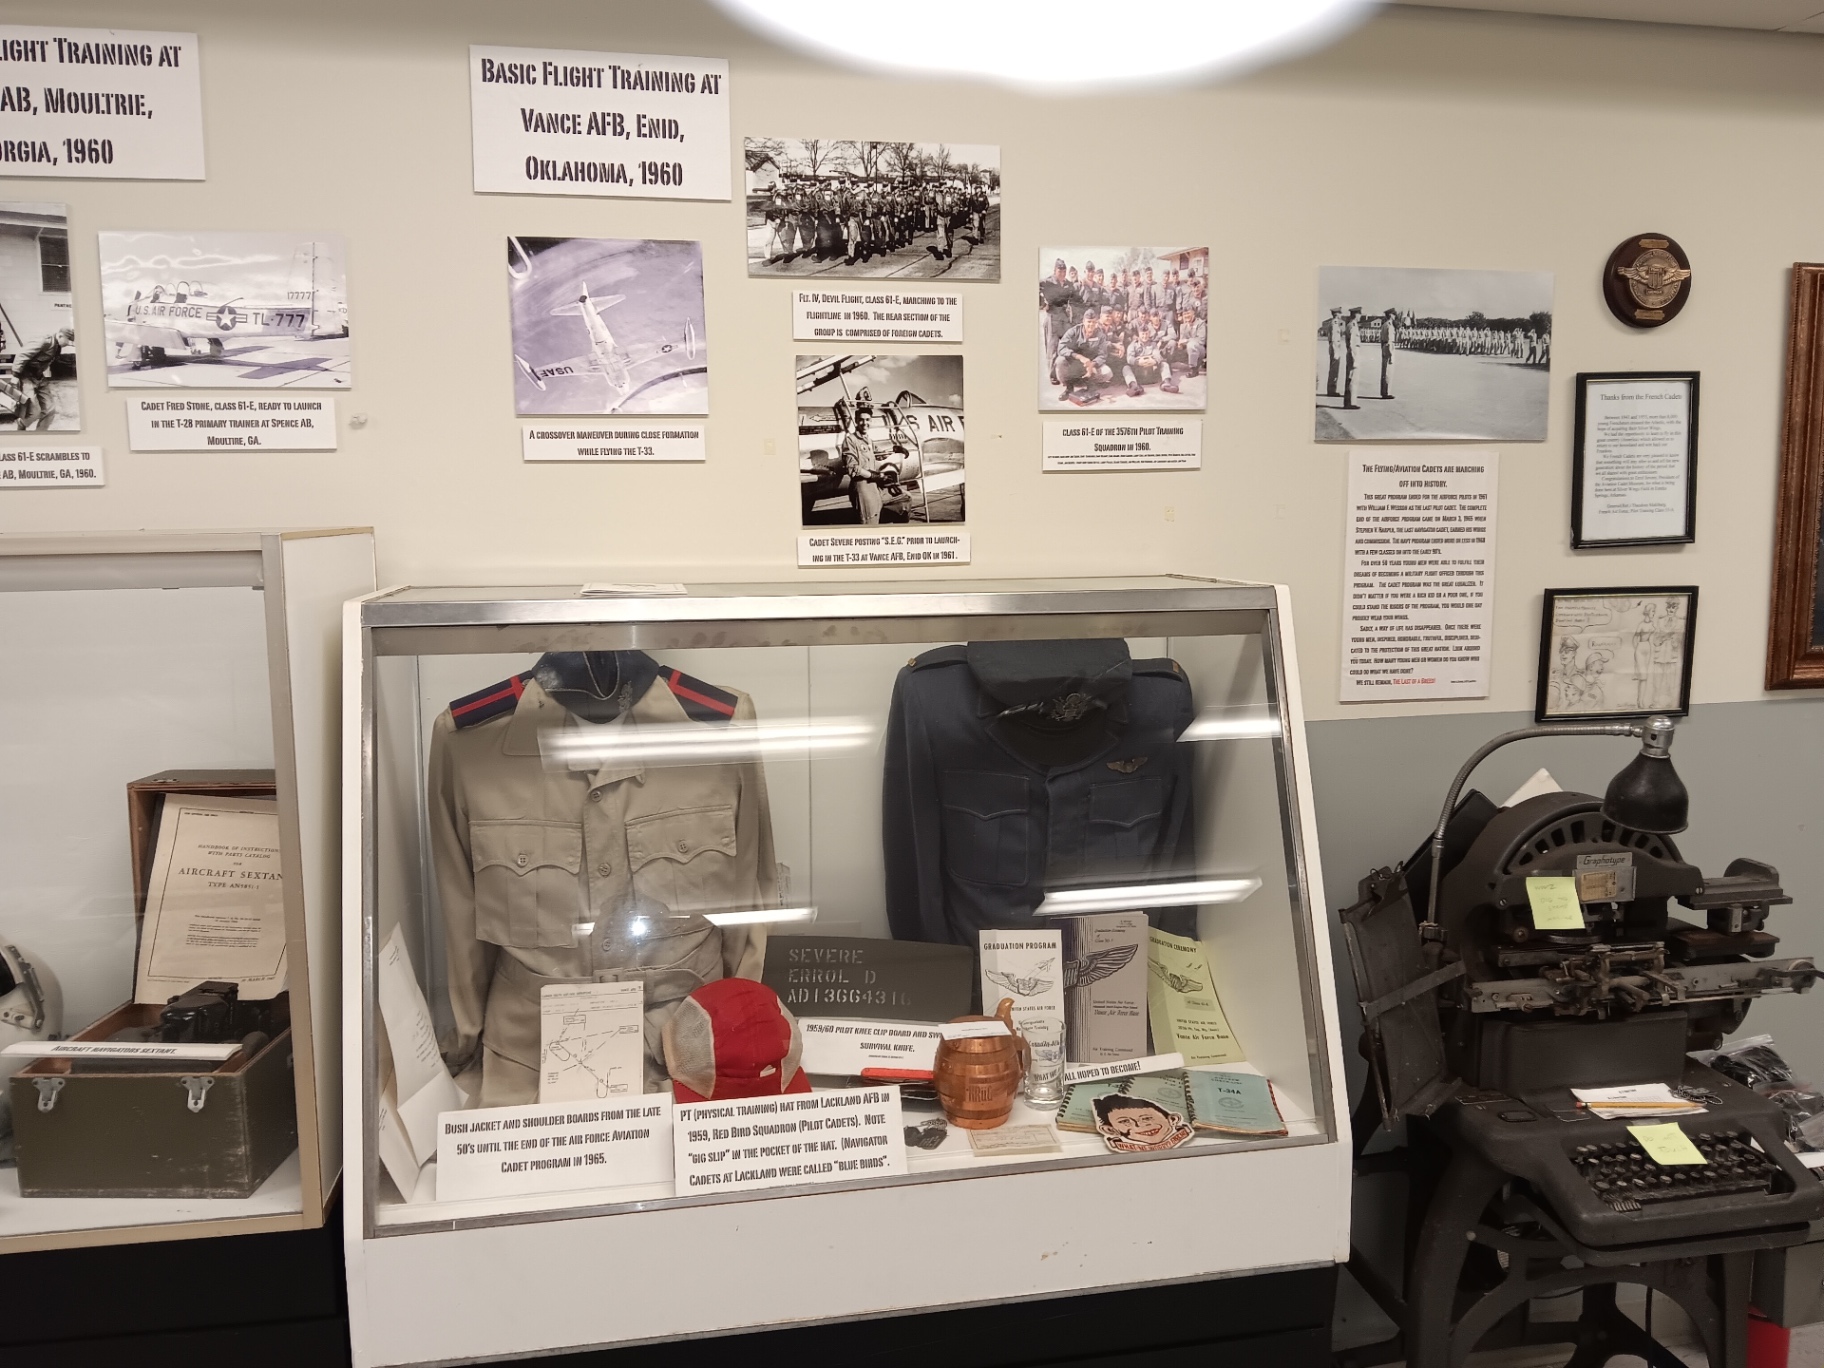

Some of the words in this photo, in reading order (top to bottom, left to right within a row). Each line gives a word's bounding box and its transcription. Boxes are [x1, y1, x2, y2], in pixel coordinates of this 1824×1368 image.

[0, 40, 48, 62] IGHT
[53, 38, 152, 66] TRAINING
[159, 46, 181, 67] AT
[481, 58, 537, 85] BASIC
[542, 61, 604, 88] FLIGHT
[609, 65, 695, 93] TRAINING
[700, 74, 721, 94] AT
[44, 88, 152, 119] MOULTRIE,
[520, 108, 582, 135] VANCE
[586, 112, 630, 140] AFB,
[636, 114, 685, 142] ENID,
[0, 140, 57, 165] RGIA,
[63, 139, 113, 164] 1960
[525, 156, 634, 186] OKLAHOMA,
[638, 161, 683, 186] 1960
[540, 366, 574, 378] USAF
[789, 948, 863, 964] SEVERE
[984, 942, 1024, 950] GRADUATION
[788, 969, 849, 983] ERROL
[865, 970, 876, 984] D
[680, 1109, 691, 1122] PT
[694, 1107, 735, 1122] (PHYSICAL
[737, 1101, 778, 1116] TRAINING)
[779, 1101, 795, 1112] HAT
[797, 1099, 819, 1111] FROM
[820, 1095, 862, 1109] LACKLAND
[863, 1092, 880, 1104] AFB
[445, 1122, 468, 1135] BUSH
[469, 1120, 501, 1133] JACKET
[502, 1119, 521, 1130] AND
[522, 1115, 565, 1128] SHOULDER
[566, 1112, 599, 1125] BOARDS
[601, 1110, 624, 1121] FROM
[626, 1108, 641, 1119] THE
[642, 1106, 661, 1117] LATE
[688, 1131, 711, 1143] 1959,
[712, 1128, 729, 1140] RED
[731, 1126, 751, 1138] BIRD
[752, 1122, 797, 1137] SQUADRON
[798, 1119, 823, 1134] (PILOT
[825, 1115, 861, 1129] CADETS).
[864, 1114, 886, 1126] NOTE
[477, 1142, 501, 1153] UNTIL
[503, 1140, 519, 1151] THE
[521, 1138, 537, 1150] END
[539, 1137, 550, 1148] OF
[551, 1136, 567, 1147] THE
[568, 1134, 583, 1145] AIR
[585, 1132, 610, 1144] FORCE
[612, 1128, 650, 1142] AVIATION
[742, 1148, 758, 1159] THE
[760, 1144, 790, 1158] POCKET
[792, 1143, 802, 1154] OF
[803, 1142, 818, 1153] THE
[820, 1140, 837, 1151] HAT.
[841, 1135, 888, 1151] (NAVIGATOR
[501, 1161, 528, 1173] CADET
[530, 1157, 571, 1170] PROGRAM
[583, 1153, 607, 1166] 1965.
[689, 1173, 721, 1186] CADETS
[723, 1172, 733, 1183] AT
[734, 1168, 777, 1183] LACKLAND
[778, 1165, 802, 1177] WERE
[803, 1162, 833, 1175] CALLED
